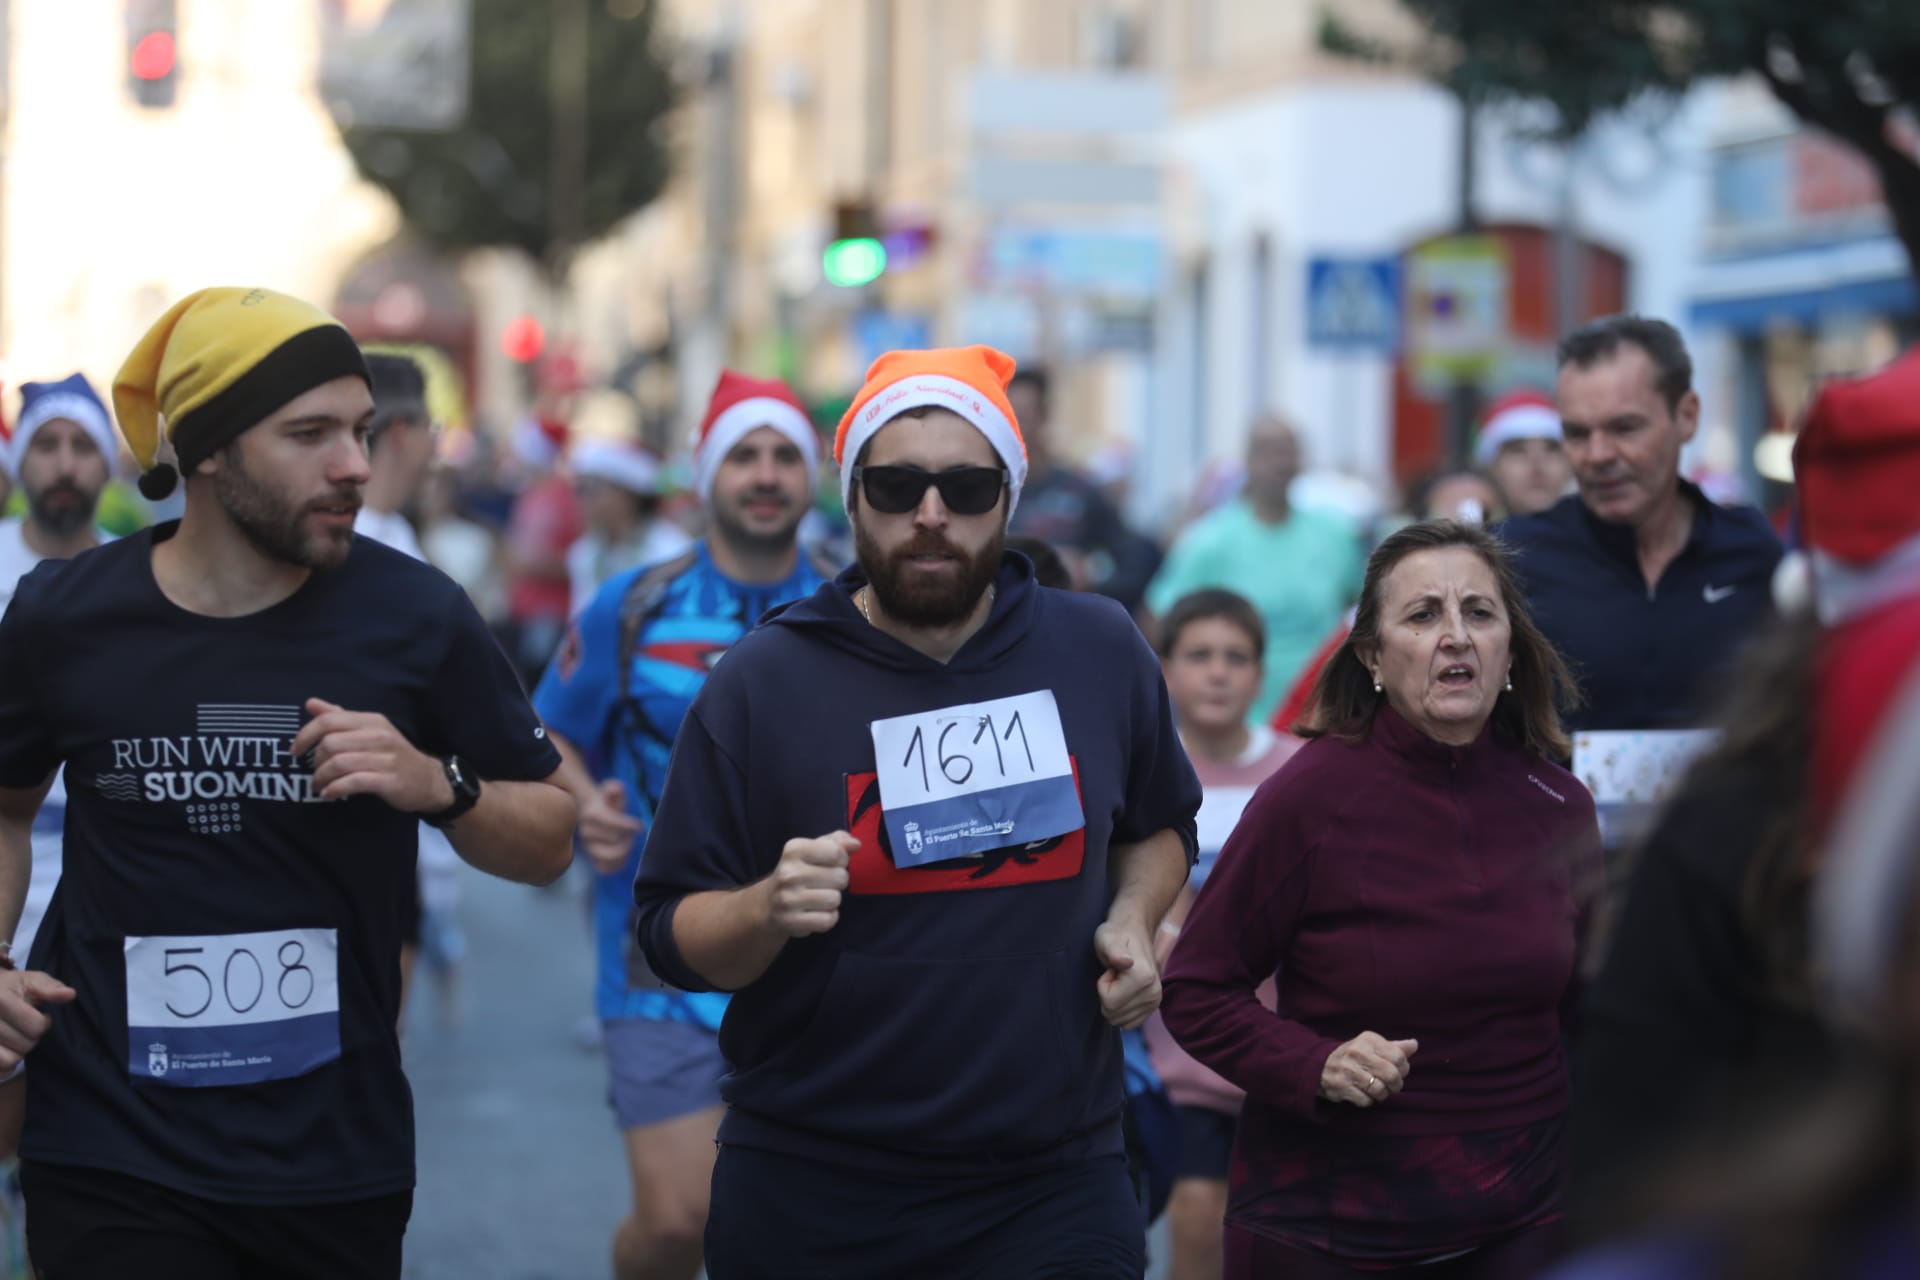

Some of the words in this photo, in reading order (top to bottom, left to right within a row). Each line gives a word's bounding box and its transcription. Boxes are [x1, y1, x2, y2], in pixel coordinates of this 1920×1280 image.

[112, 736, 191, 768] RUN
[197, 736, 300, 768] WITH
[903, 710, 1036, 792] 1611
[934, 831, 959, 843] Puerto
[970, 823, 993, 835] Santa
[164, 940, 314, 1019] 508
[172, 1061, 180, 1069] El
[181, 1061, 208, 1069] Puerto
[209, 1059, 220, 1068] de
[221, 1059, 245, 1067] Santa
